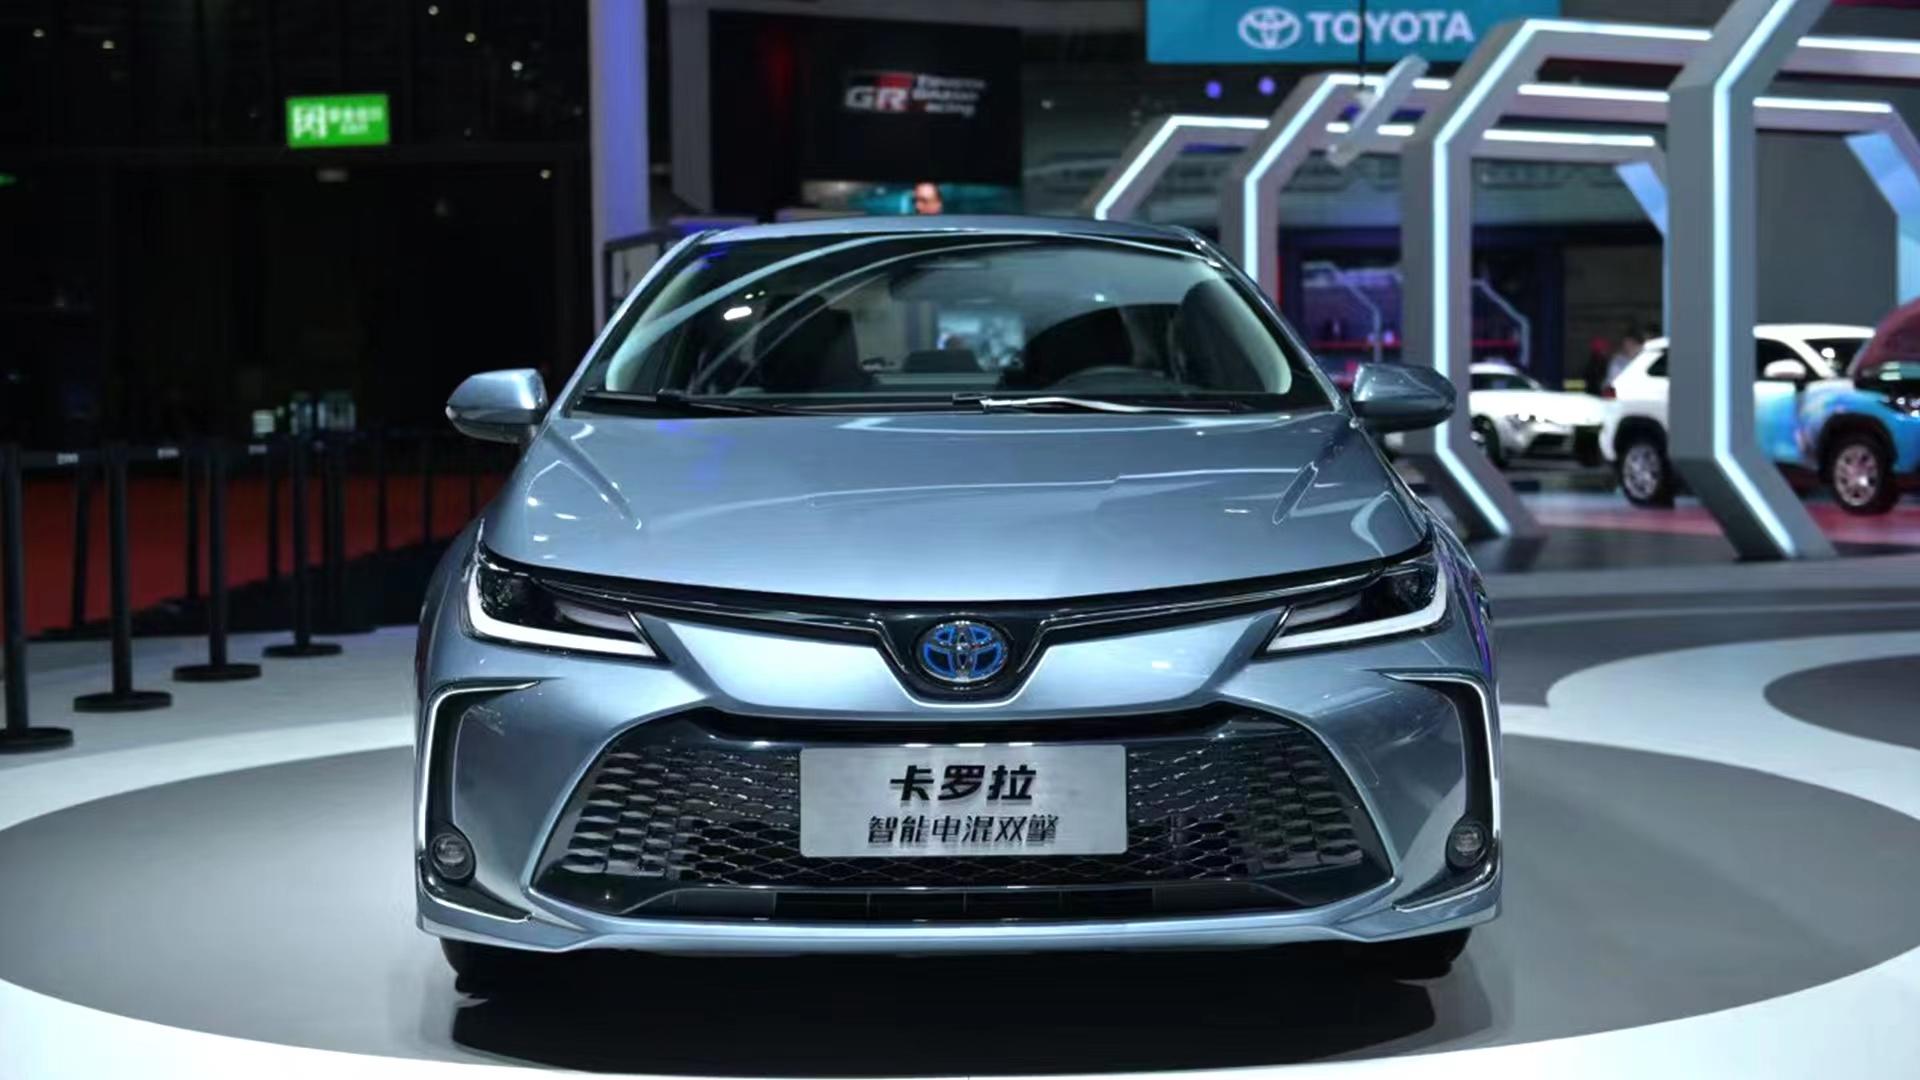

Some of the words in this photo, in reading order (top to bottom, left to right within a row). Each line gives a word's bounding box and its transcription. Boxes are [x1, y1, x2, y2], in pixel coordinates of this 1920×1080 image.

[1307, 11, 1475, 43] TOYOTA
[846, 86, 908, 112] GR
[889, 764, 1036, 800] 卡罗拉
[868, 814, 1059, 843] 智能电混双擎
